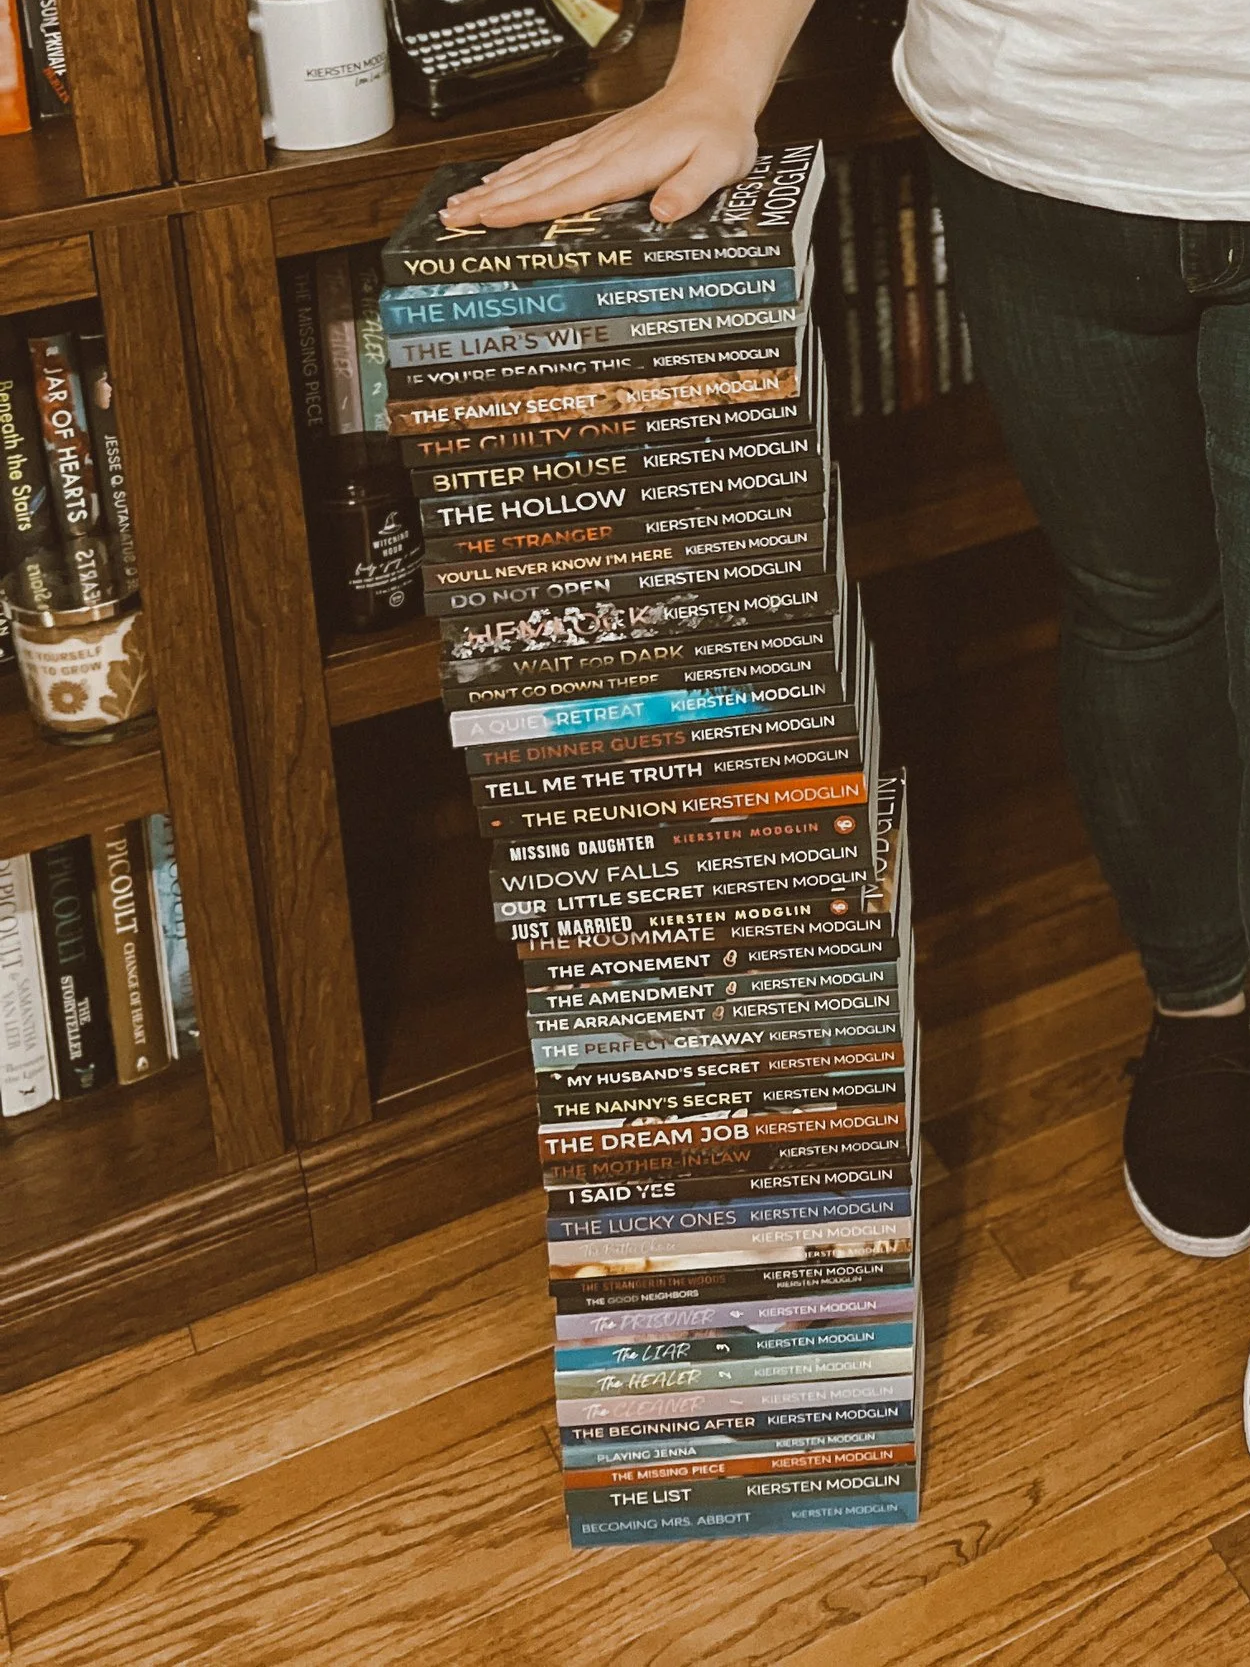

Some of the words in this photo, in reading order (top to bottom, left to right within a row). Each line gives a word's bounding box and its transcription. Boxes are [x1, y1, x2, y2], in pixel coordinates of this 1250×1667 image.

[305, 61, 361, 78] KIERSTEN
[756, 145, 815, 227] MODGLIN
[404, 258, 455, 276] YOU
[461, 255, 511, 273] CAN
[516, 252, 591, 270] TRUST
[598, 250, 632, 267] ME
[643, 248, 711, 262] KIERSTEN
[714, 246, 780, 259] MODGLIN
[388, 303, 445, 325] THE
[453, 293, 566, 320] MISSING
[597, 286, 684, 306] KIERSTEN
[689, 279, 776, 299] MODGLIN
[402, 341, 452, 363] THE
[461, 334, 538, 356] LIAR'S
[547, 325, 610, 347] WIFE
[630, 317, 712, 337] KIERSTEN
[716, 308, 796, 328] MODGLIN
[43, 368, 68, 403] JAR
[305, 381, 323, 427] PIECE
[411, 409, 450, 425] THE
[454, 402, 522, 421] FAMILY
[526, 394, 597, 413] SECRET
[626, 384, 701, 403] KIERSTEN
[705, 377, 779, 395] MODGLIN
[52, 410, 74, 439] OF
[7, 454, 28, 481] the
[104, 435, 122, 472] JESSE
[433, 467, 524, 493] BITTER
[533, 456, 627, 482] HOUSE
[643, 448, 725, 469] KIERSTEN
[729, 439, 808, 459] MODGLIN
[57, 446, 88, 523] HEARTS
[437, 504, 494, 527] THE
[501, 488, 626, 519] HOLLOW
[641, 480, 723, 502] KIERSTEN
[727, 470, 808, 490] MODGLIN
[12, 484, 32, 532] Stairs
[437, 569, 492, 585] YOU'LL
[495, 562, 547, 578] NEVER
[552, 556, 601, 572] KNOW
[605, 553, 627, 566] I'M
[631, 548, 673, 563] HERE
[685, 541, 746, 556] KIERSTEN
[749, 533, 808, 548] MODGLIN
[482, 749, 521, 766] THE
[526, 740, 604, 762] DINNER
[610, 730, 686, 752] GUESTS
[691, 723, 762, 742] KIERSTEN
[765, 715, 835, 734] MODGLIN
[485, 780, 537, 799] TELL
[542, 776, 577, 793] ME
[582, 771, 625, 789] THE
[630, 762, 702, 784] TRUTH
[714, 754, 781, 773] KIERSTEN
[783, 748, 849, 765] MODGLIN
[521, 811, 567, 828] THE
[573, 800, 677, 823] REUNION
[682, 792, 770, 813] KIERSTEN
[774, 784, 859, 804] MODGLIN
[509, 843, 570, 862] MISSING
[578, 835, 655, 856] DAUGHTER
[672, 829, 742, 845] KIERSTEN
[750, 822, 819, 837] MODGLIN
[105, 838, 138, 935] PICOULT
[501, 868, 599, 893] WIDOW
[607, 861, 679, 883] FALLS
[697, 853, 776, 873] KIERSTEN
[780, 846, 858, 863] MODGLIN
[500, 899, 547, 917] OUR
[558, 892, 622, 912] LITTLE
[627, 884, 705, 905] SECRET
[712, 878, 789, 897] KIERSTEN
[792, 871, 867, 888] MODGLIN
[61, 975, 83, 1060] STORYTELLER
[77, 997, 91, 1026] THE
[536, 1018, 569, 1032] THE
[573, 1009, 706, 1030] ARRANGEMENT
[732, 1000, 810, 1018] KIERSTEN
[814, 995, 890, 1012] MODGLIN
[567, 1075, 592, 1088] MY
[597, 1067, 694, 1085] HUSBAND'S
[697, 1061, 760, 1077] SECRET
[768, 1055, 831, 1071] KIERSTEN
[834, 1051, 895, 1065] MODGLIN
[544, 1136, 594, 1155] THE
[601, 1128, 693, 1151] DREAM
[700, 1124, 750, 1143] JOB
[755, 1118, 826, 1136] KIERSTEN
[829, 1114, 899, 1130] MODGLIN
[560, 1220, 602, 1237] THE
[609, 1214, 676, 1234] LUCKY
[680, 1211, 737, 1229] ONES
[750, 1207, 819, 1222] KIERSTEN
[823, 1202, 894, 1217] MODGLIN
[572, 1427, 604, 1440] THE
[609, 1421, 700, 1437] BEGINNING
[704, 1417, 756, 1430] AFTER
[767, 1412, 832, 1425] KIERSTEN
[835, 1407, 899, 1420] MODGLIN
[609, 1492, 648, 1507] THE
[653, 1489, 692, 1504] LIST
[747, 1480, 822, 1497] KIERSTEN
[826, 1474, 900, 1490] MODGLIN
[581, 1519, 658, 1534] BECOMING
[697, 1512, 752, 1525] ABBOTT
[792, 1507, 843, 1520] KIERSTEN
[845, 1504, 898, 1515] MODGLIN
